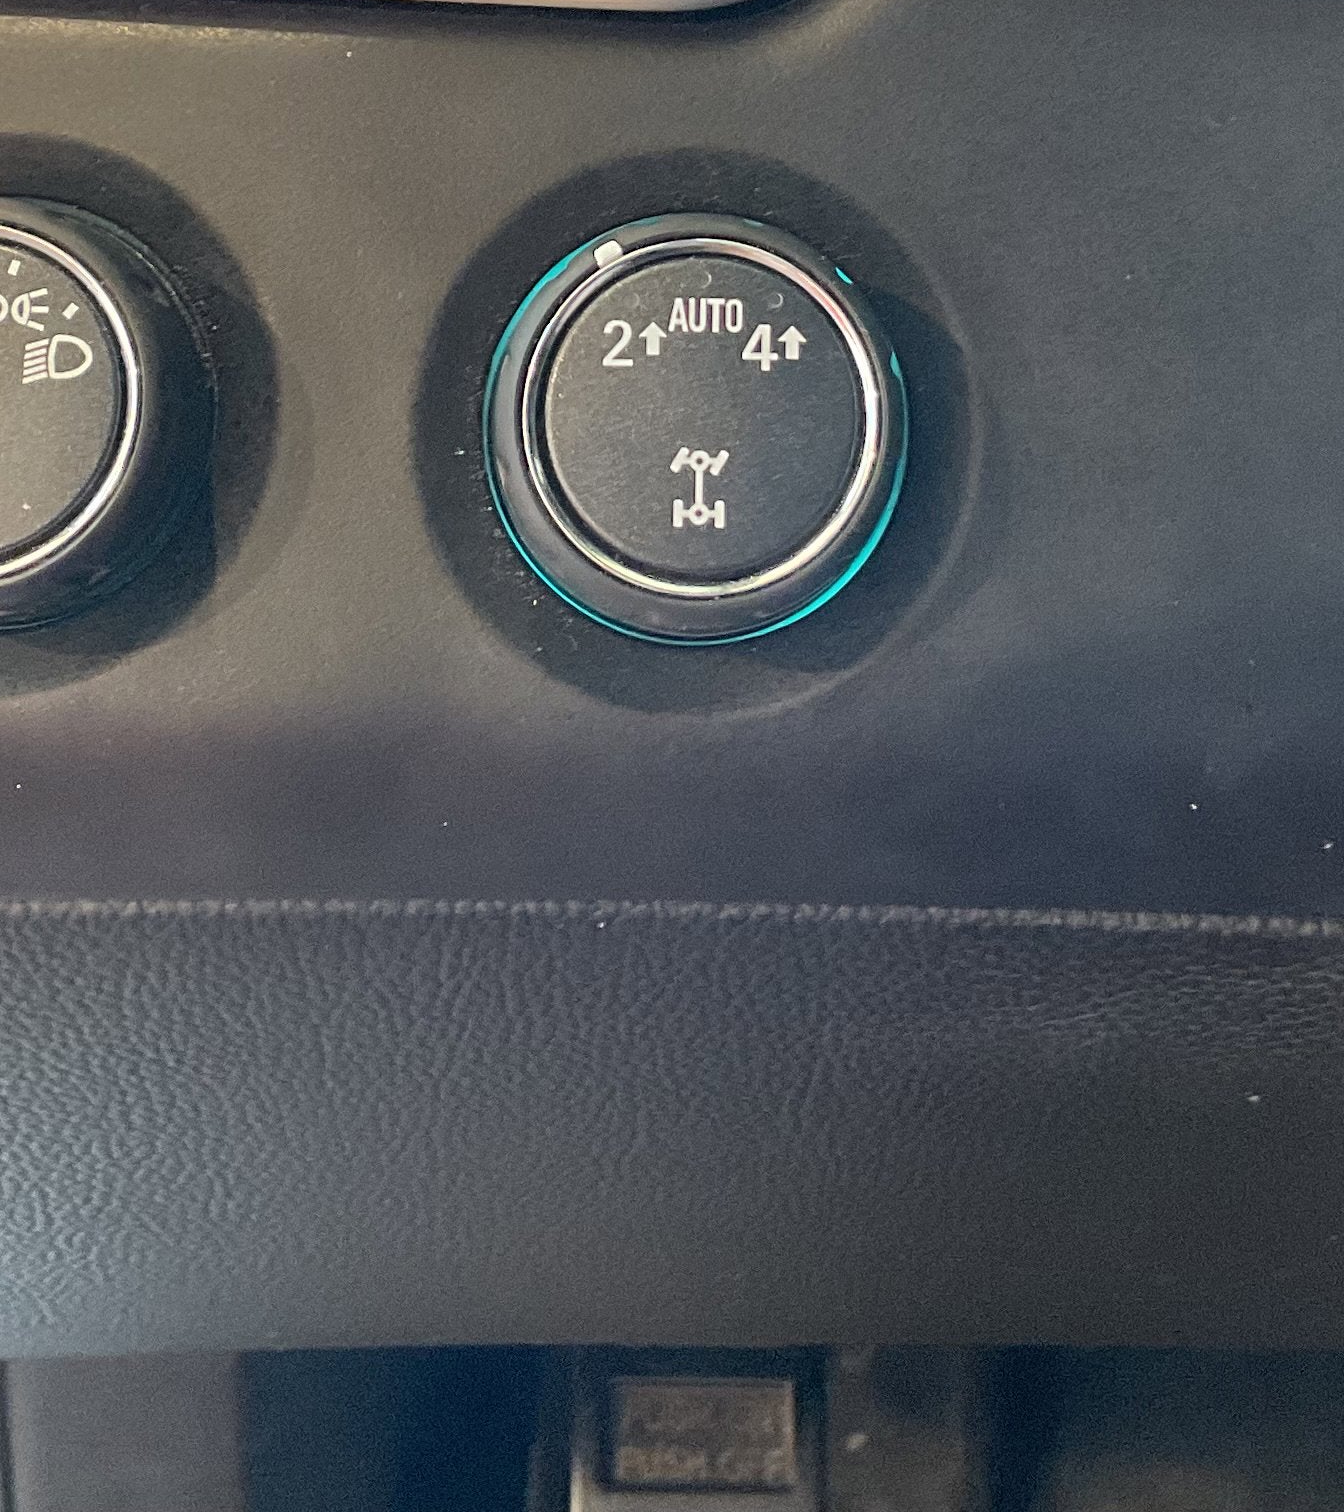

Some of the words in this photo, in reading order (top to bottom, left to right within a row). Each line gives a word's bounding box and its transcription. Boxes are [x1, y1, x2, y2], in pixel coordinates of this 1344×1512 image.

[667, 297, 744, 334] AUTO
[601, 319, 635, 368] 2
[741, 323, 780, 372] 4
